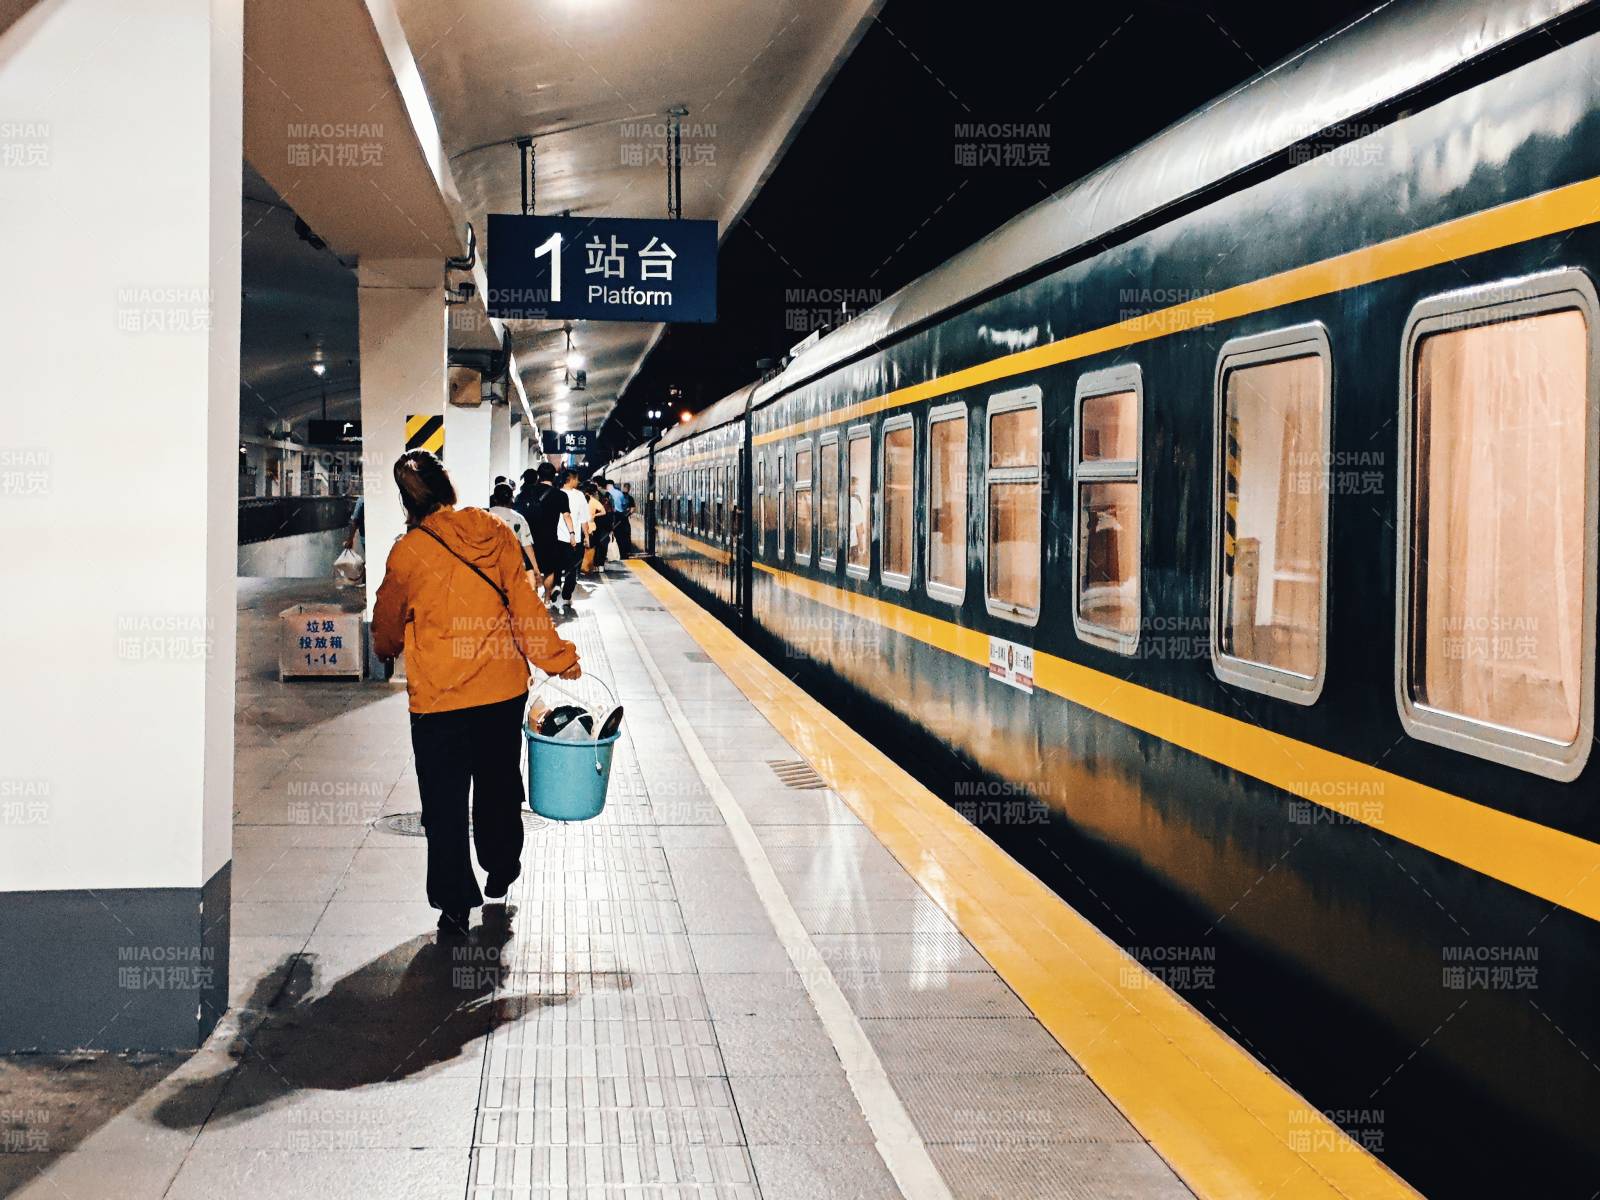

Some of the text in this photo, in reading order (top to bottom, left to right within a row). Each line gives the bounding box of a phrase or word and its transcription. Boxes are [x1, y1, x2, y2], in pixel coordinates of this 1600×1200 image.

[534, 232, 677, 302] 1 站台
[588, 285, 673, 306] Platform
[565, 433, 587, 446] 站台
[306, 620, 334, 633] 垃圾
[299, 636, 343, 650] 投放箱
[305, 652, 338, 665] 1-14
